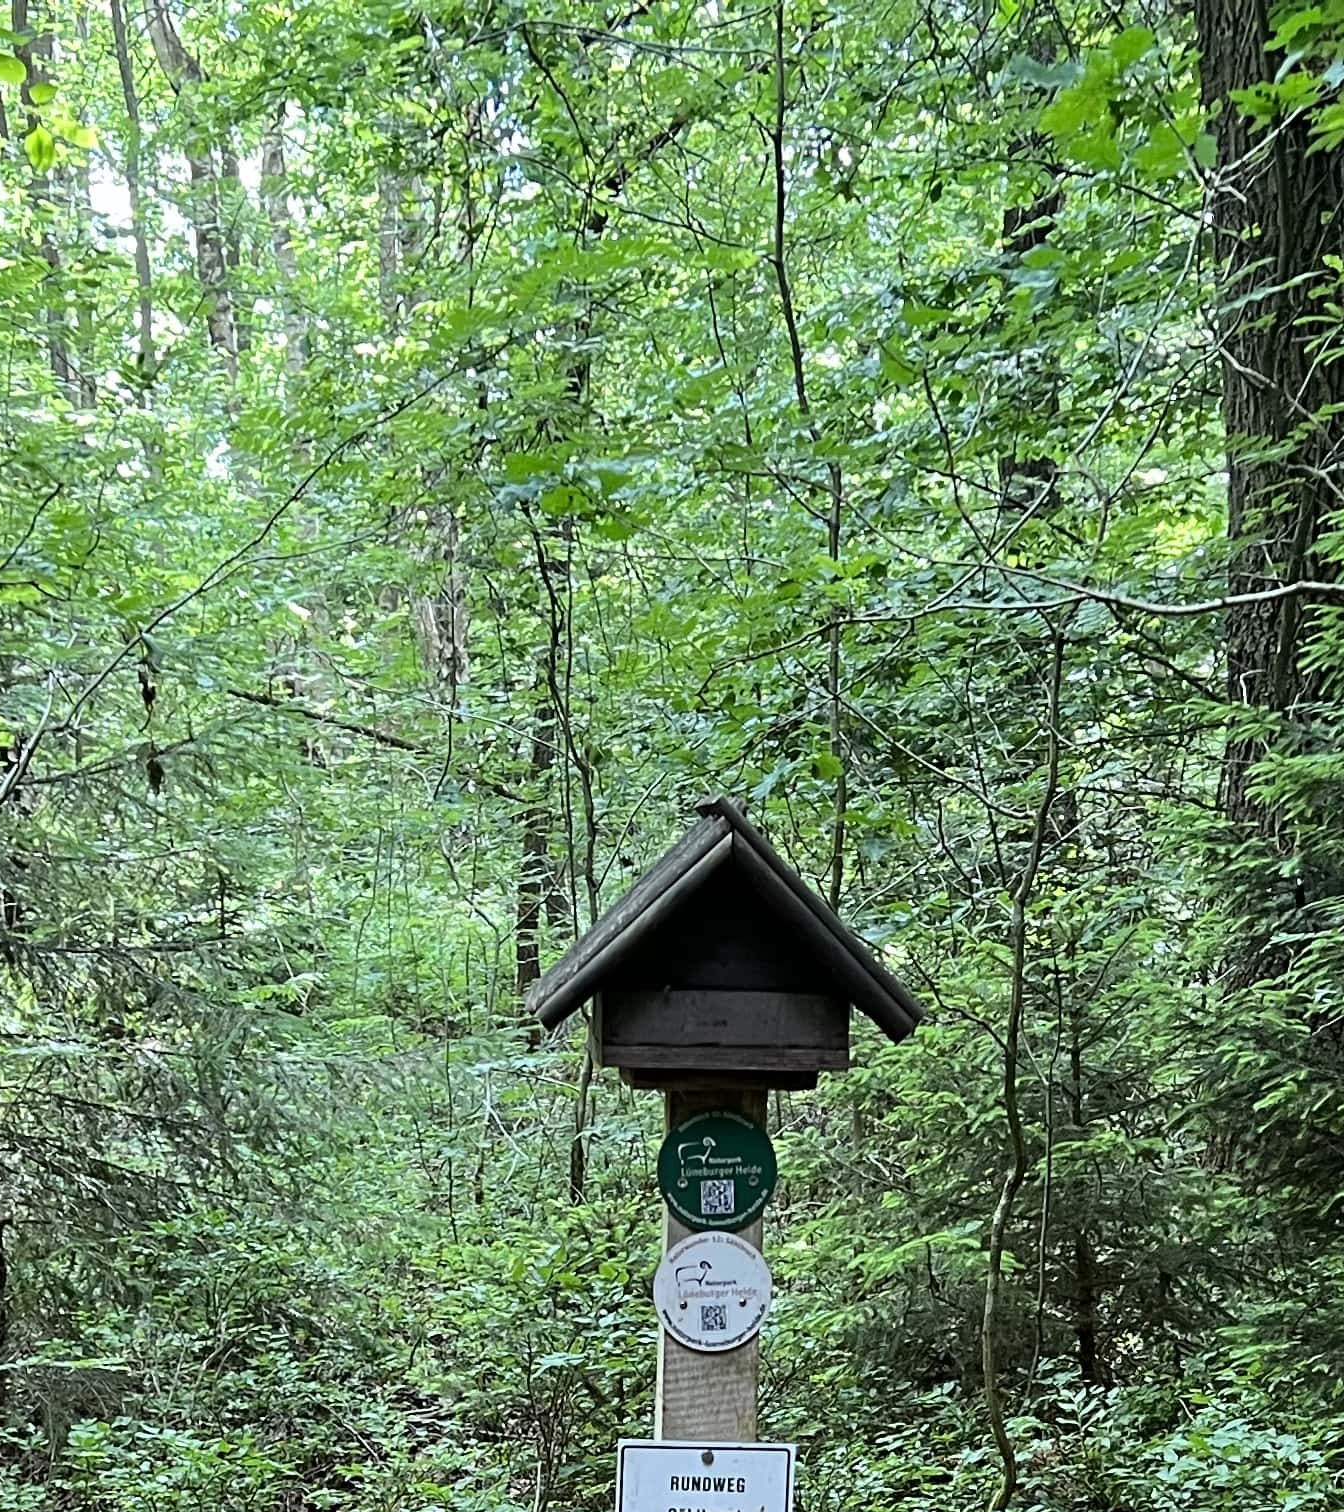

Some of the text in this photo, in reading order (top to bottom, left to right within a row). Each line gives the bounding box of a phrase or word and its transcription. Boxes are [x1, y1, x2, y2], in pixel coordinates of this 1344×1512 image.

[681, 1165, 762, 1178] Lüneburger Heide
[731, 1287, 758, 1296] Heide
[670, 1476, 746, 1493] RUNDWEG
